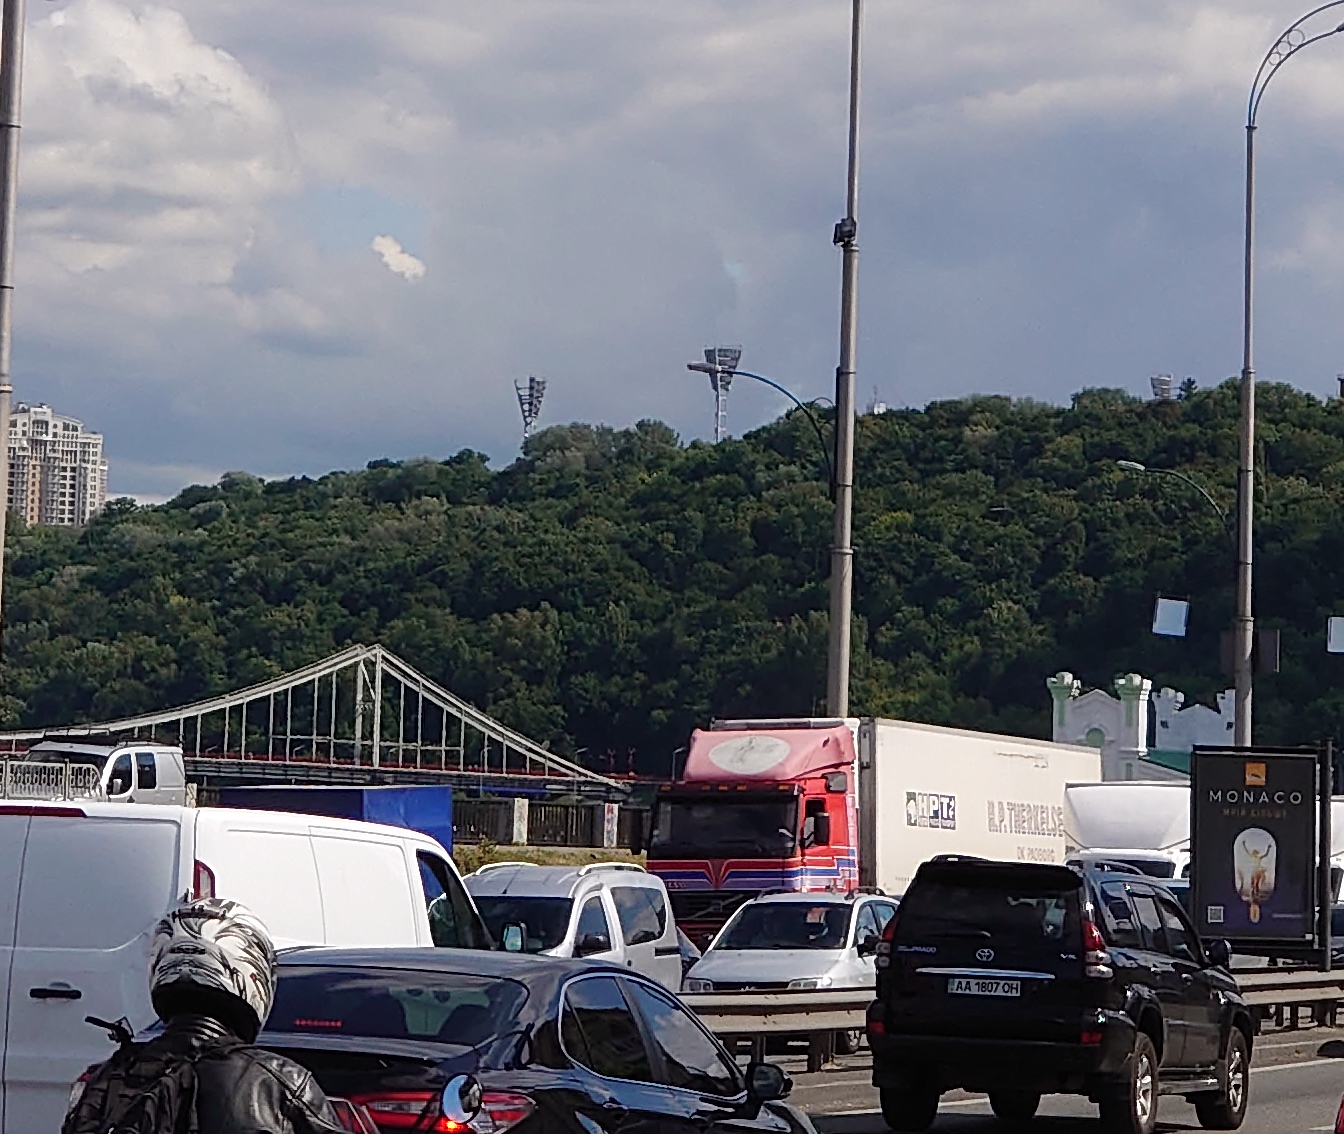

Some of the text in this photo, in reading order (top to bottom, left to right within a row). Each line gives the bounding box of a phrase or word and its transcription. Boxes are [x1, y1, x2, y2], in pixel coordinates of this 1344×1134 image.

[1209, 790, 1302, 805] MONACO
[955, 980, 1019, 995] AA 1807 OH
